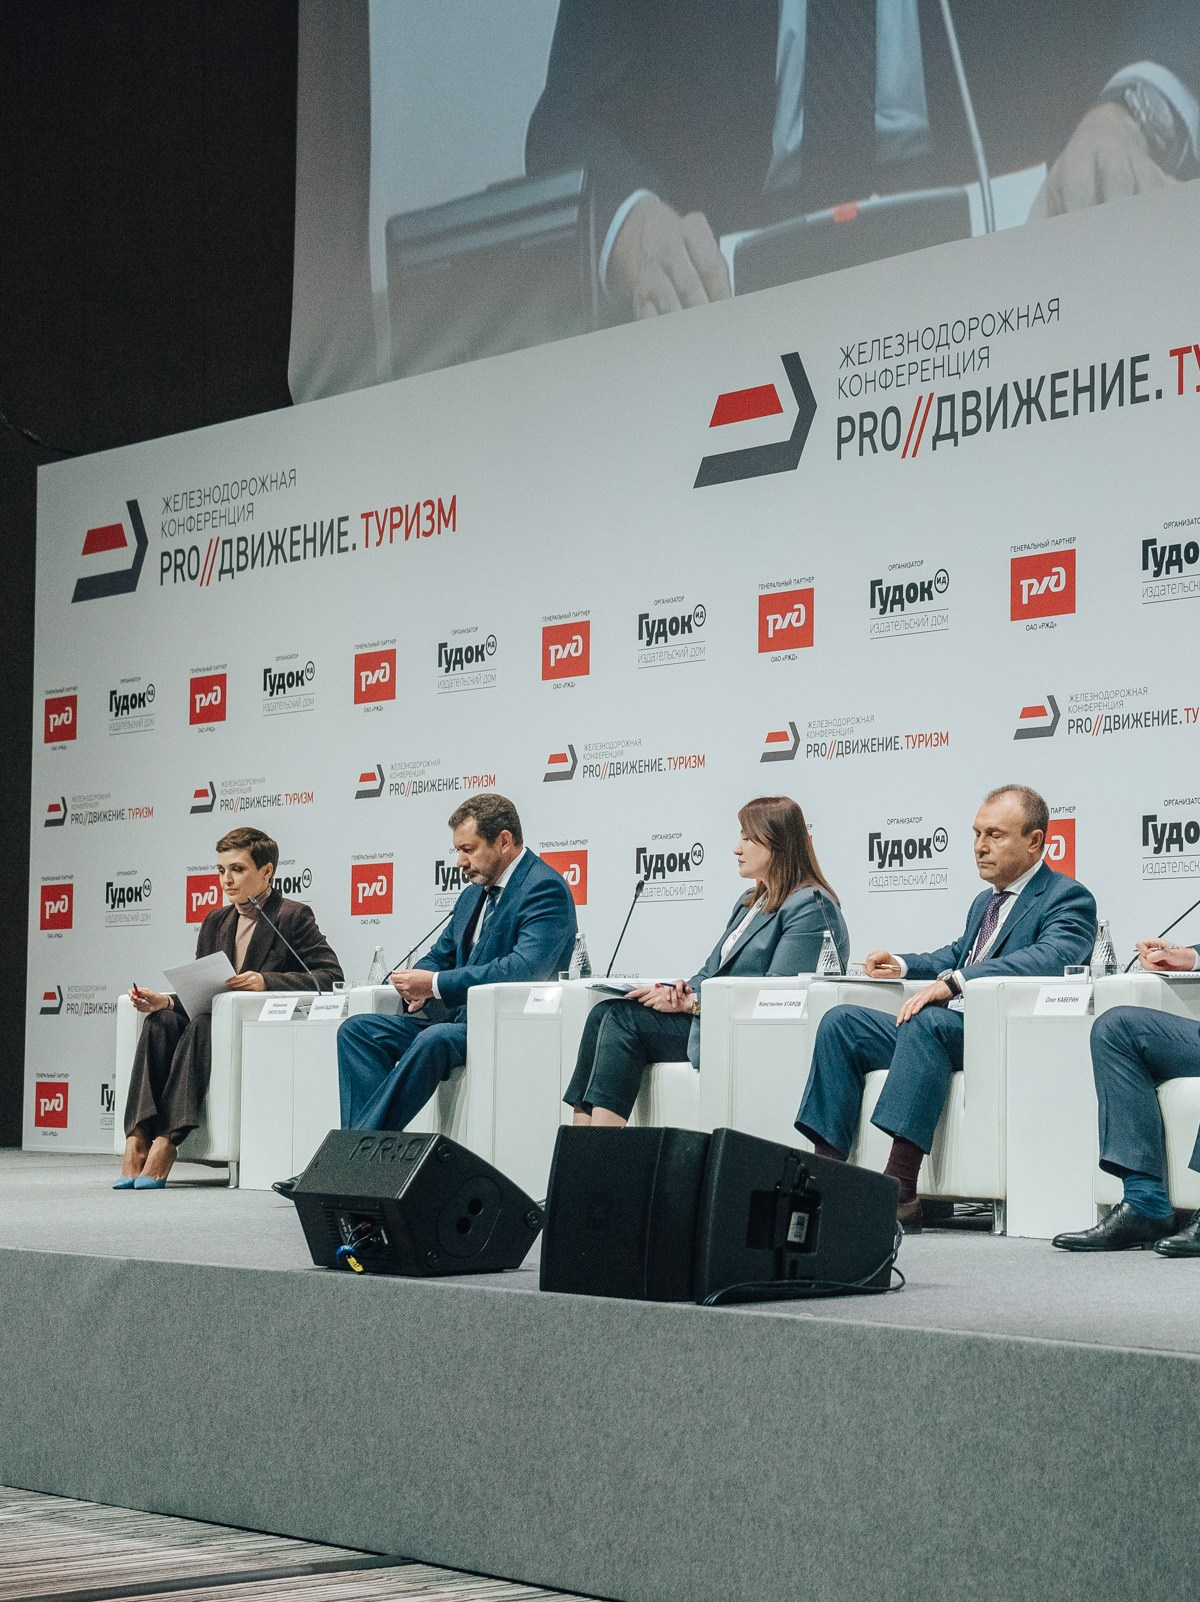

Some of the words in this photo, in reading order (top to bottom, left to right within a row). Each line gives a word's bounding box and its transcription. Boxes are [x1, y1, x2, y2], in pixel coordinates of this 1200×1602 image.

[839, 298, 1060, 370] ЖЕЛЕЗНОДОРОЖНАЯ
[838, 346, 990, 399] КОНФЕРЕНЦИЯ
[162, 469, 297, 515] ЖЕЛЕЗНОДОРОЖНАЯ
[161, 503, 254, 539] КОНФЕРЕНЦИЯ
[1011, 541, 1049, 552] ГЕНЕРАЛЬНЫЙ
[1052, 537, 1076, 546] ПАРТНЕР
[888, 560, 924, 571] ОРГАНИЗАТОР
[758, 579, 792, 590] ГЕНЕРАЛЬНЫЙ
[794, 576, 815, 585] ПАРТНЕР
[654, 596, 684, 606] ОРГАНИЗАТОР
[870, 578, 933, 615] Гудок
[638, 613, 692, 646] Гудок
[438, 642, 485, 673] Гудок
[263, 668, 304, 697] Гудок
[1069, 687, 1148, 703] ЖЕЛЕЗНОДОРОЖНАЯ
[110, 690, 146, 717] Гудок
[1068, 700, 1124, 713] КОНФЕРЕНЦИЯ
[808, 715, 875, 729] ЖЕЛЕЗНОДОРОЖНАЯ
[807, 727, 854, 739] КОНФЕРЕНЦИЯ
[584, 739, 642, 752] ЖЕЛЕЗНОДОРОЖНАЯ
[583, 750, 624, 761] КОНФЕРЕНЦИЯ
[1051, 806, 1076, 814] ПАРТНЕР
[887, 817, 923, 825] ОРГАНИЗАТОР
[869, 832, 932, 870] Гудок
[636, 847, 691, 881] Гудок
[106, 882, 142, 909] Гудок
[640, 884, 687, 898] дательский
